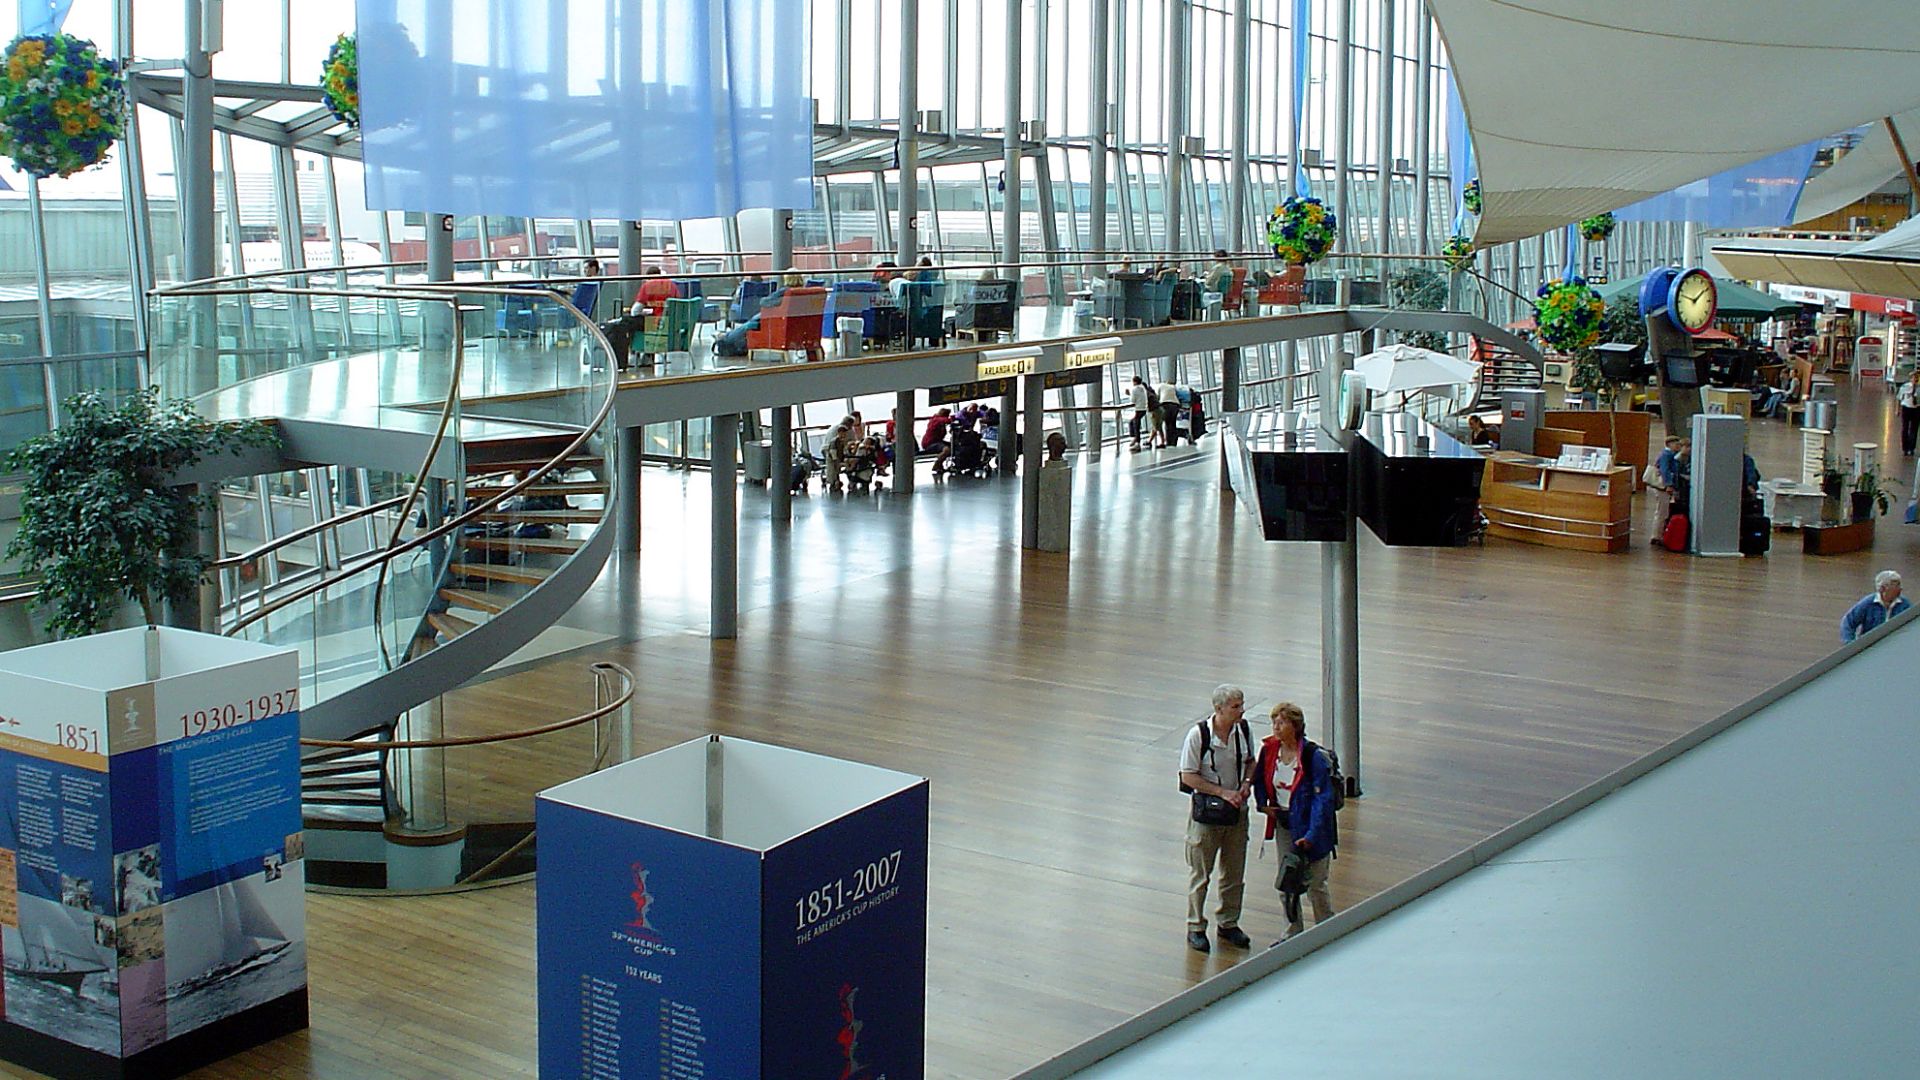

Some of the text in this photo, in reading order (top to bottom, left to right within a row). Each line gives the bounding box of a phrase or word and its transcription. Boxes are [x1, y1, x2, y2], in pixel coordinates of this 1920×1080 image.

[1083, 354, 1105, 363] ARLANDA
[984, 364, 1011, 375] ARLANDA
[181, 689, 297, 739] 1930-1937
[56, 722, 99, 754] 1851
[159, 745, 173, 755] THE
[796, 849, 902, 931] 1851-2007
[797, 886, 900, 945] THE AMERICA'S CUP HISTORY
[627, 937, 676, 956] AMERICA'S
[634, 945, 654, 957] CUP
[639, 969, 663, 984] YEARS
